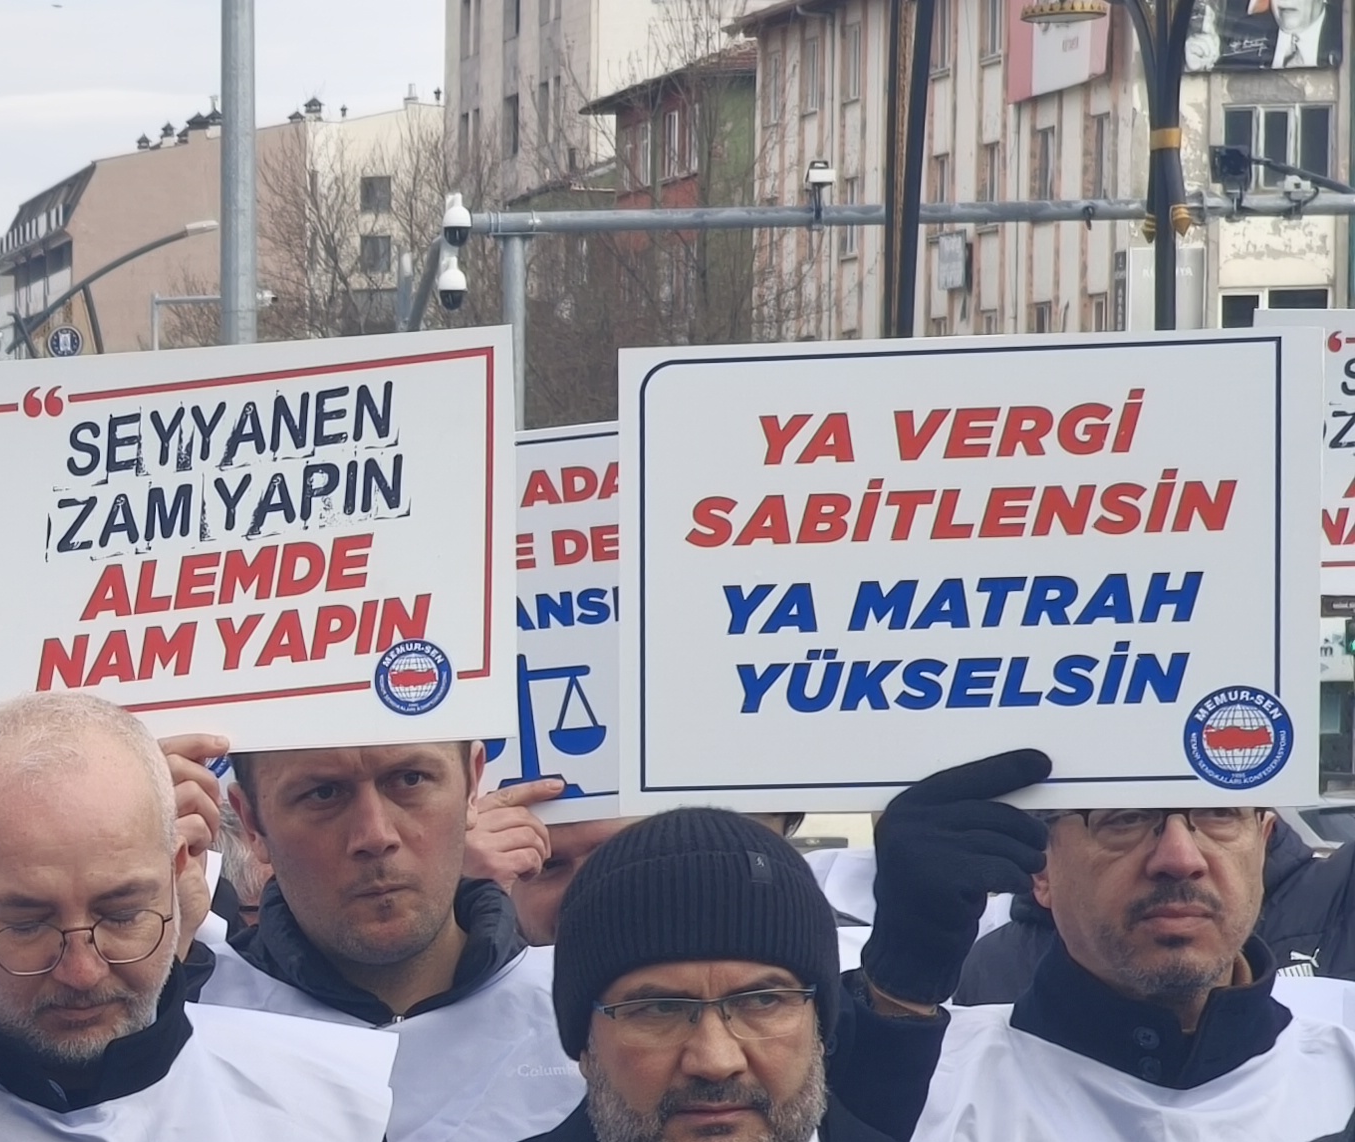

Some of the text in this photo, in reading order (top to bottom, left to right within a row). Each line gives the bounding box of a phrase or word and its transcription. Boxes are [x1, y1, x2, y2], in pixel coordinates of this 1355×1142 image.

[67, 381, 393, 476] SEYYANEN
[759, 389, 1145, 465] YA VERGİ
[57, 454, 403, 552] ZAM YAPIN
[685, 469, 1237, 547] SABİTLENSİN
[80, 534, 373, 621] ALEMDE
[723, 571, 1204, 635] YA MATRAH
[36, 594, 432, 691] NAM YAPIN
[383, 643, 444, 667] MEMUR-SEN
[736, 641, 1190, 713] YÜKSELSİN
[1194, 690, 1282, 722] MEMUR-SEN
